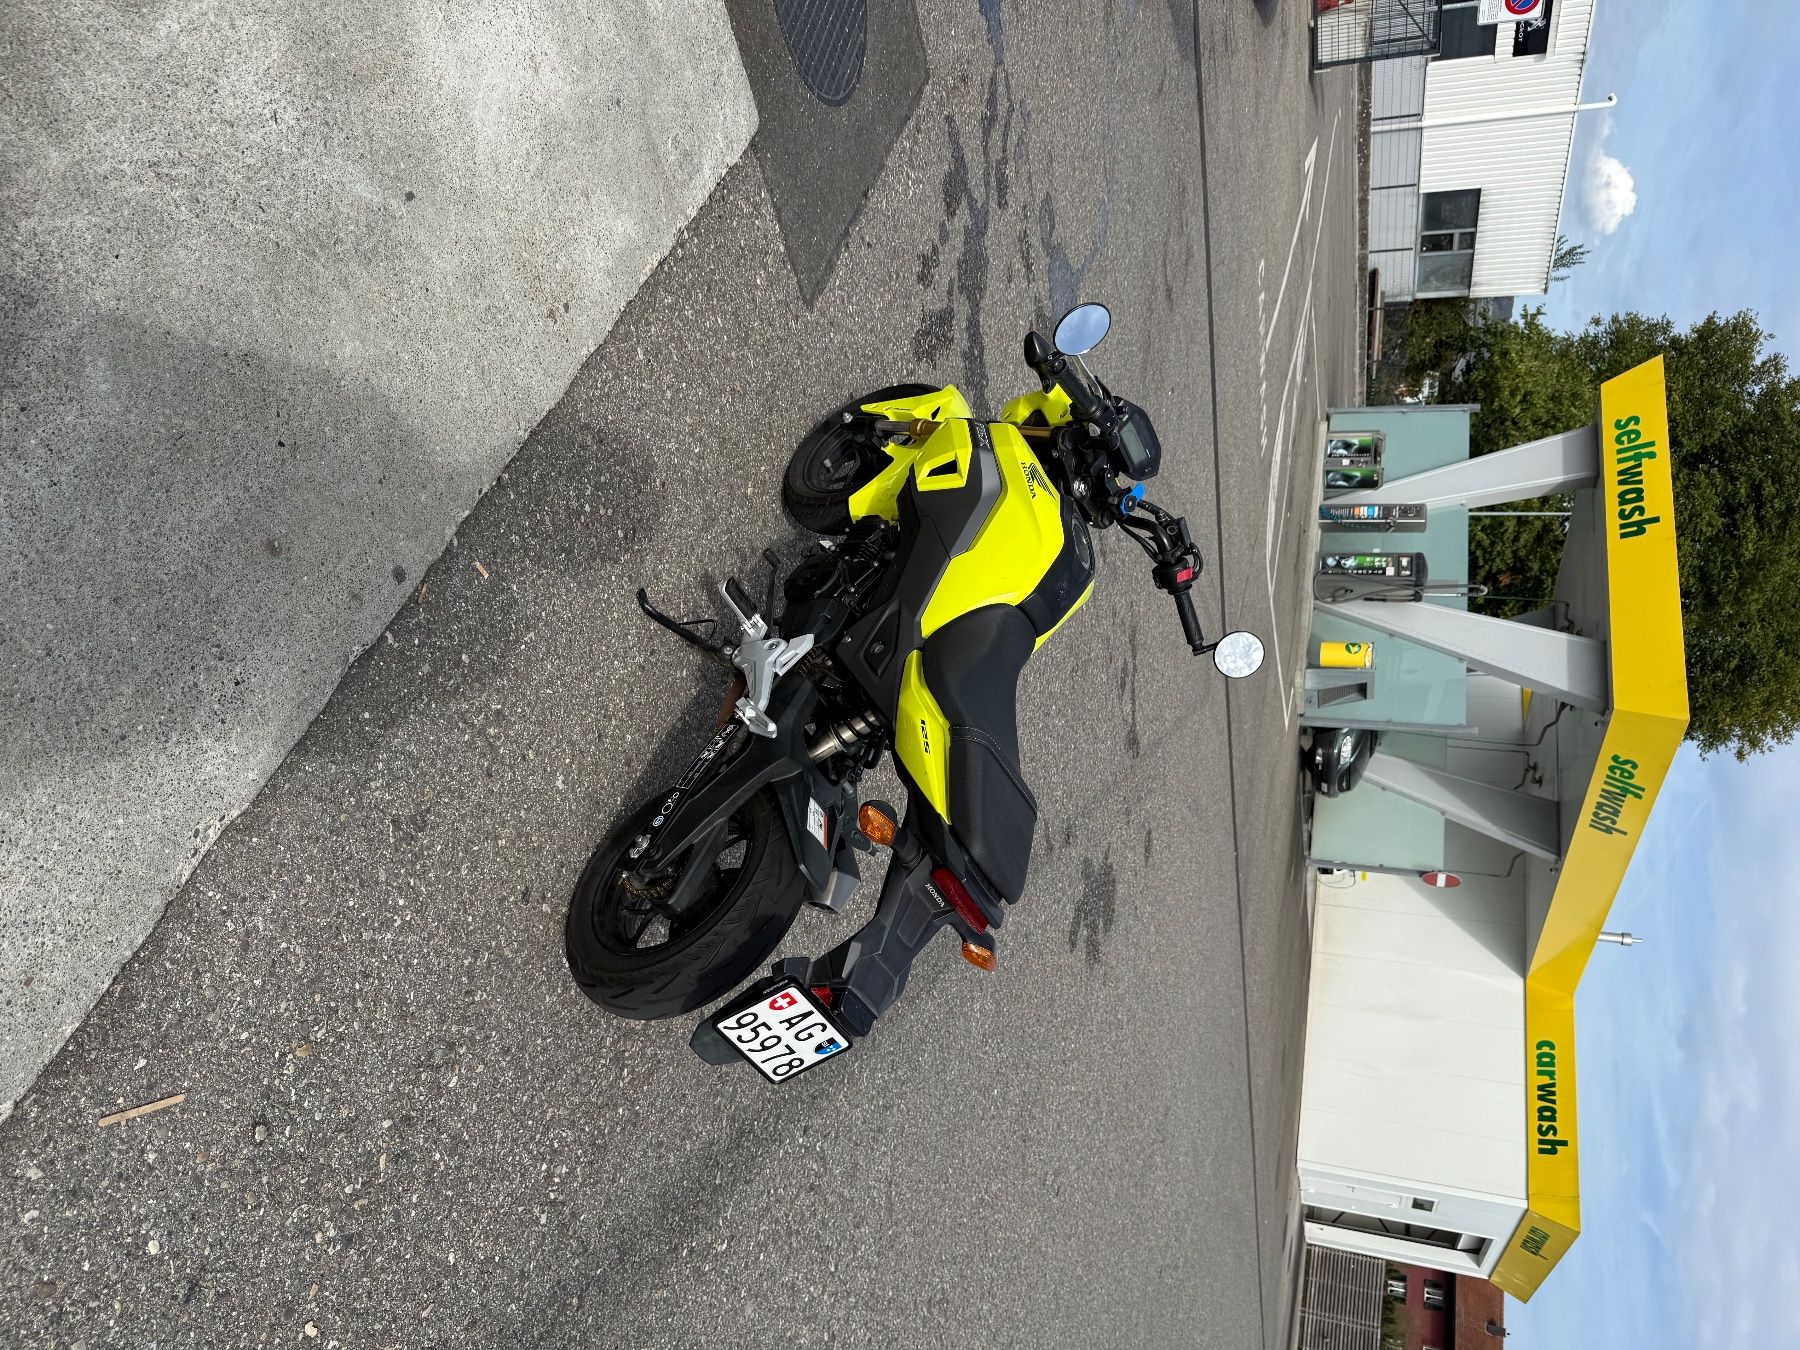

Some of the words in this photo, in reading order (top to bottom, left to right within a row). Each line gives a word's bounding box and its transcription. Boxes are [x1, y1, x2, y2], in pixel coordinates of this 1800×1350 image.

[1020, 461, 1037, 499] HONDA
[1614, 415, 1660, 539] selfwash
[1589, 754, 1645, 836] selfwash
[925, 883, 945, 908] HONDA
[723, 1012, 805, 1077] 95978
[778, 1010, 828, 1042] AG
[1536, 1040, 1569, 1156] carwash
